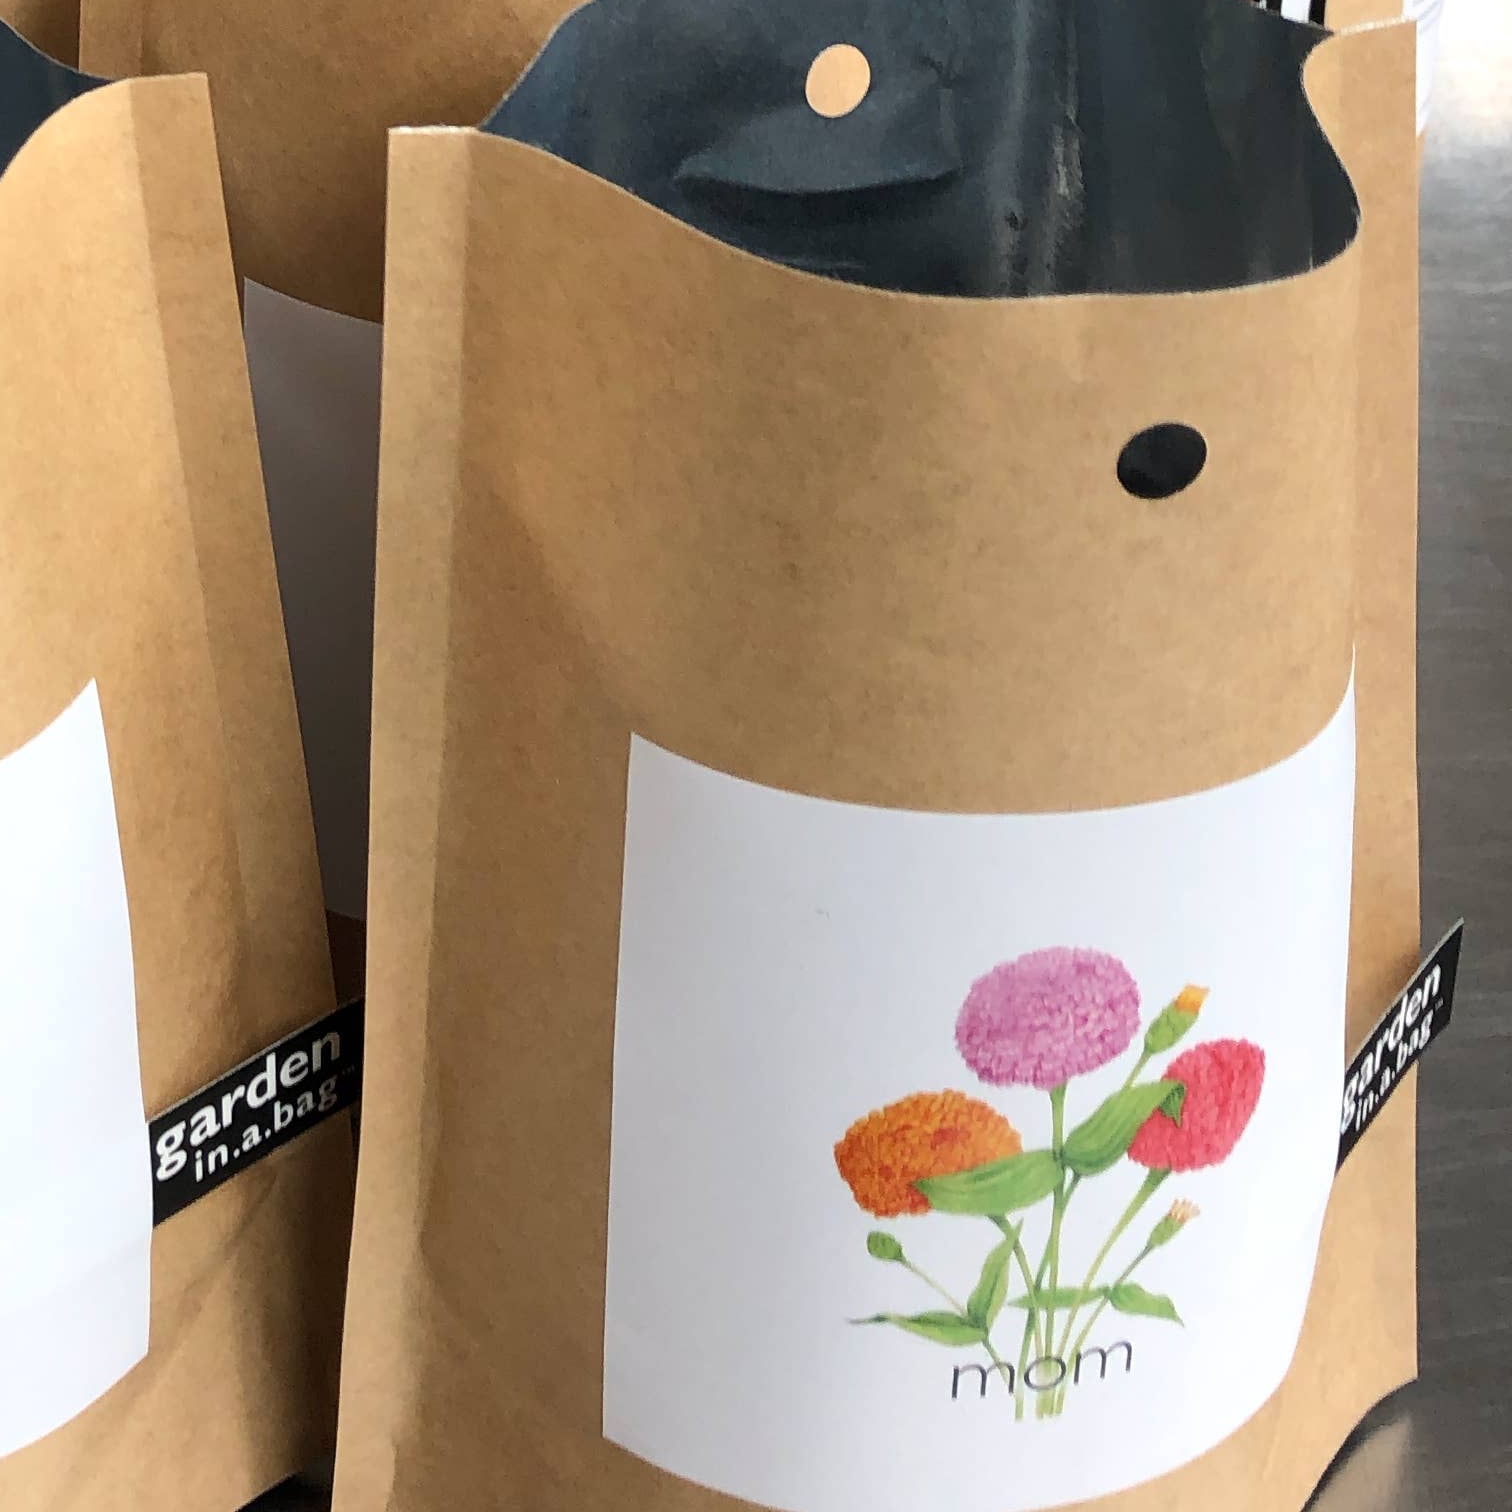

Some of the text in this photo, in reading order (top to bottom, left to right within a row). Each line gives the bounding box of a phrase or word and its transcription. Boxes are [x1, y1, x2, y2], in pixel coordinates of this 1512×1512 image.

[155, 1031, 340, 1181] garden
[1340, 963, 1442, 1137] garden
[195, 1076, 338, 1182] in.a.bag
[951, 1341, 1133, 1402] mom
